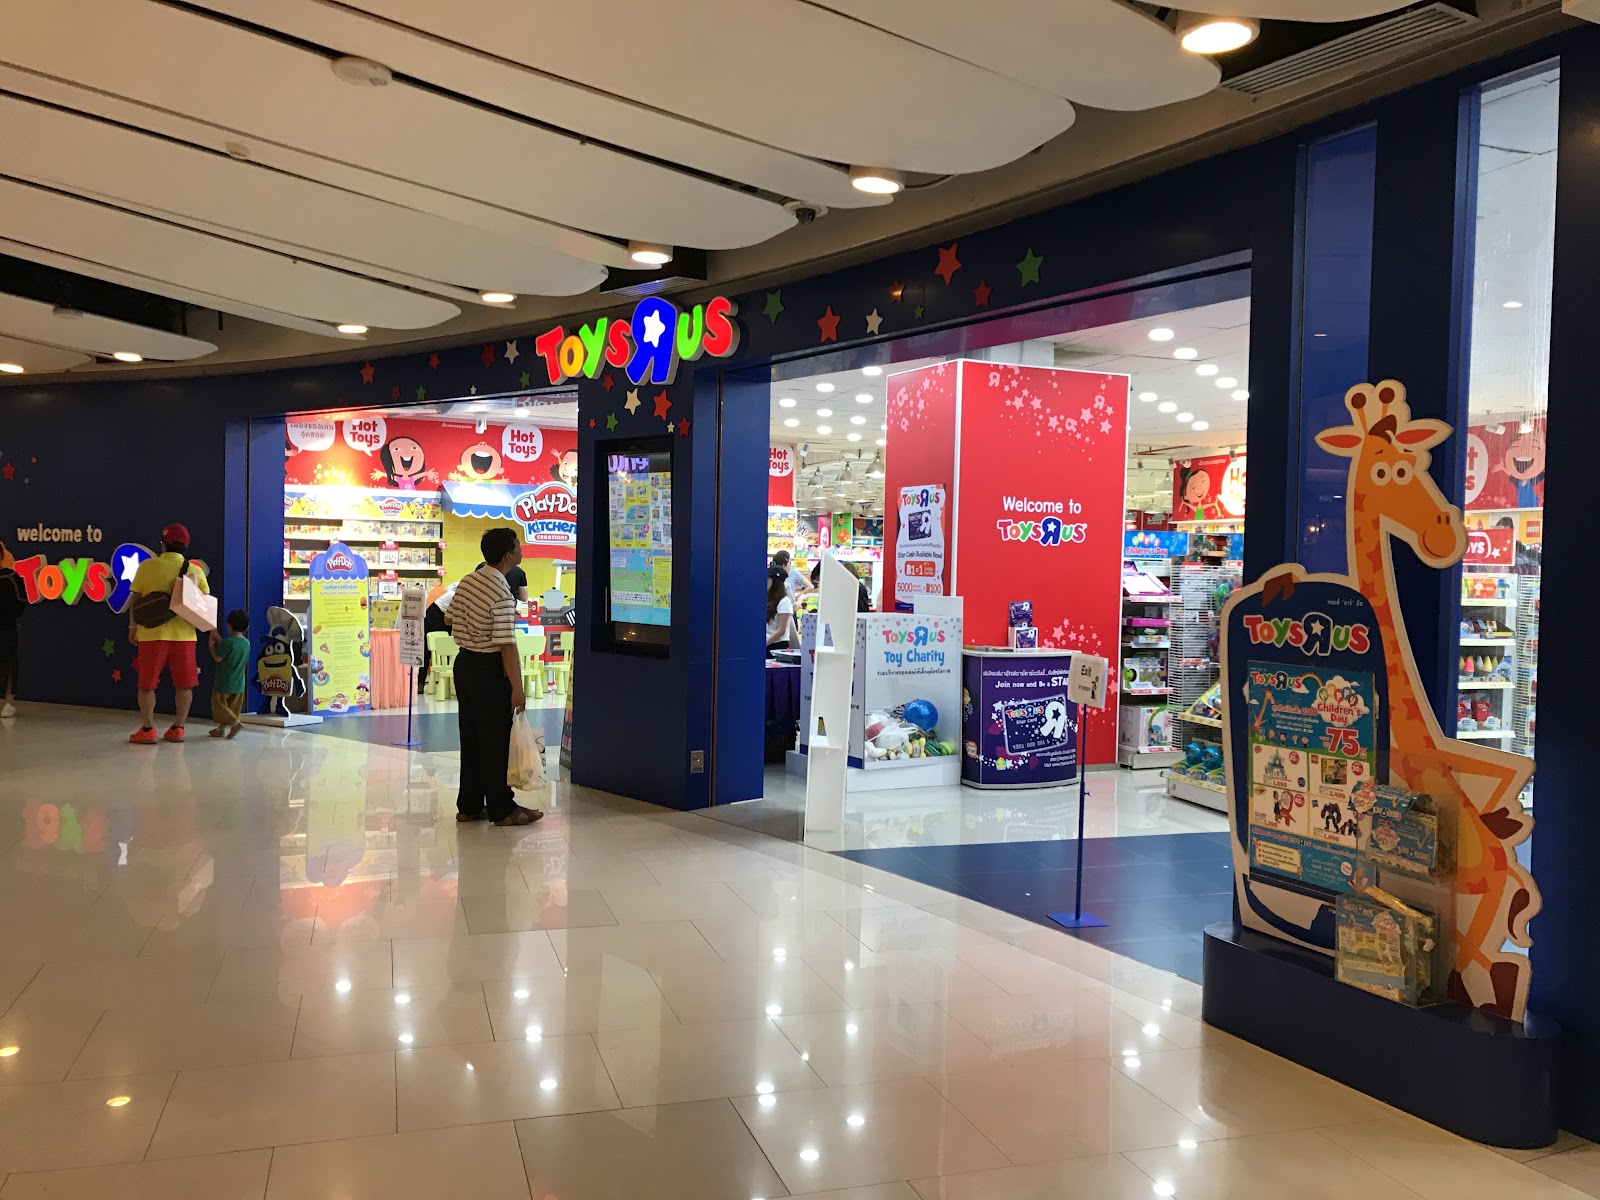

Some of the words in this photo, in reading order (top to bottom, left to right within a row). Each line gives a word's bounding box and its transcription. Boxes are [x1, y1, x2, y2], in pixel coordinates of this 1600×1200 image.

[352, 420, 378, 433] Hot
[350, 431, 380, 447] Toys
[510, 429, 535, 443] Hot
[508, 443, 537, 458] Toys
[769, 448, 787, 460] Hot
[1002, 496, 1063, 513] Welcome
[1068, 498, 1082, 514] to
[17, 523, 82, 543] welcome
[87, 524, 103, 543] to
[1156, 547, 1168, 556] Day
[883, 651, 903, 668] Toy
[906, 648, 945, 667] Charity
[995, 680, 1011, 688] Join
[1317, 702, 1362, 718] Children's
[1330, 713, 1348, 726] Day
[1326, 727, 1361, 757] 75
